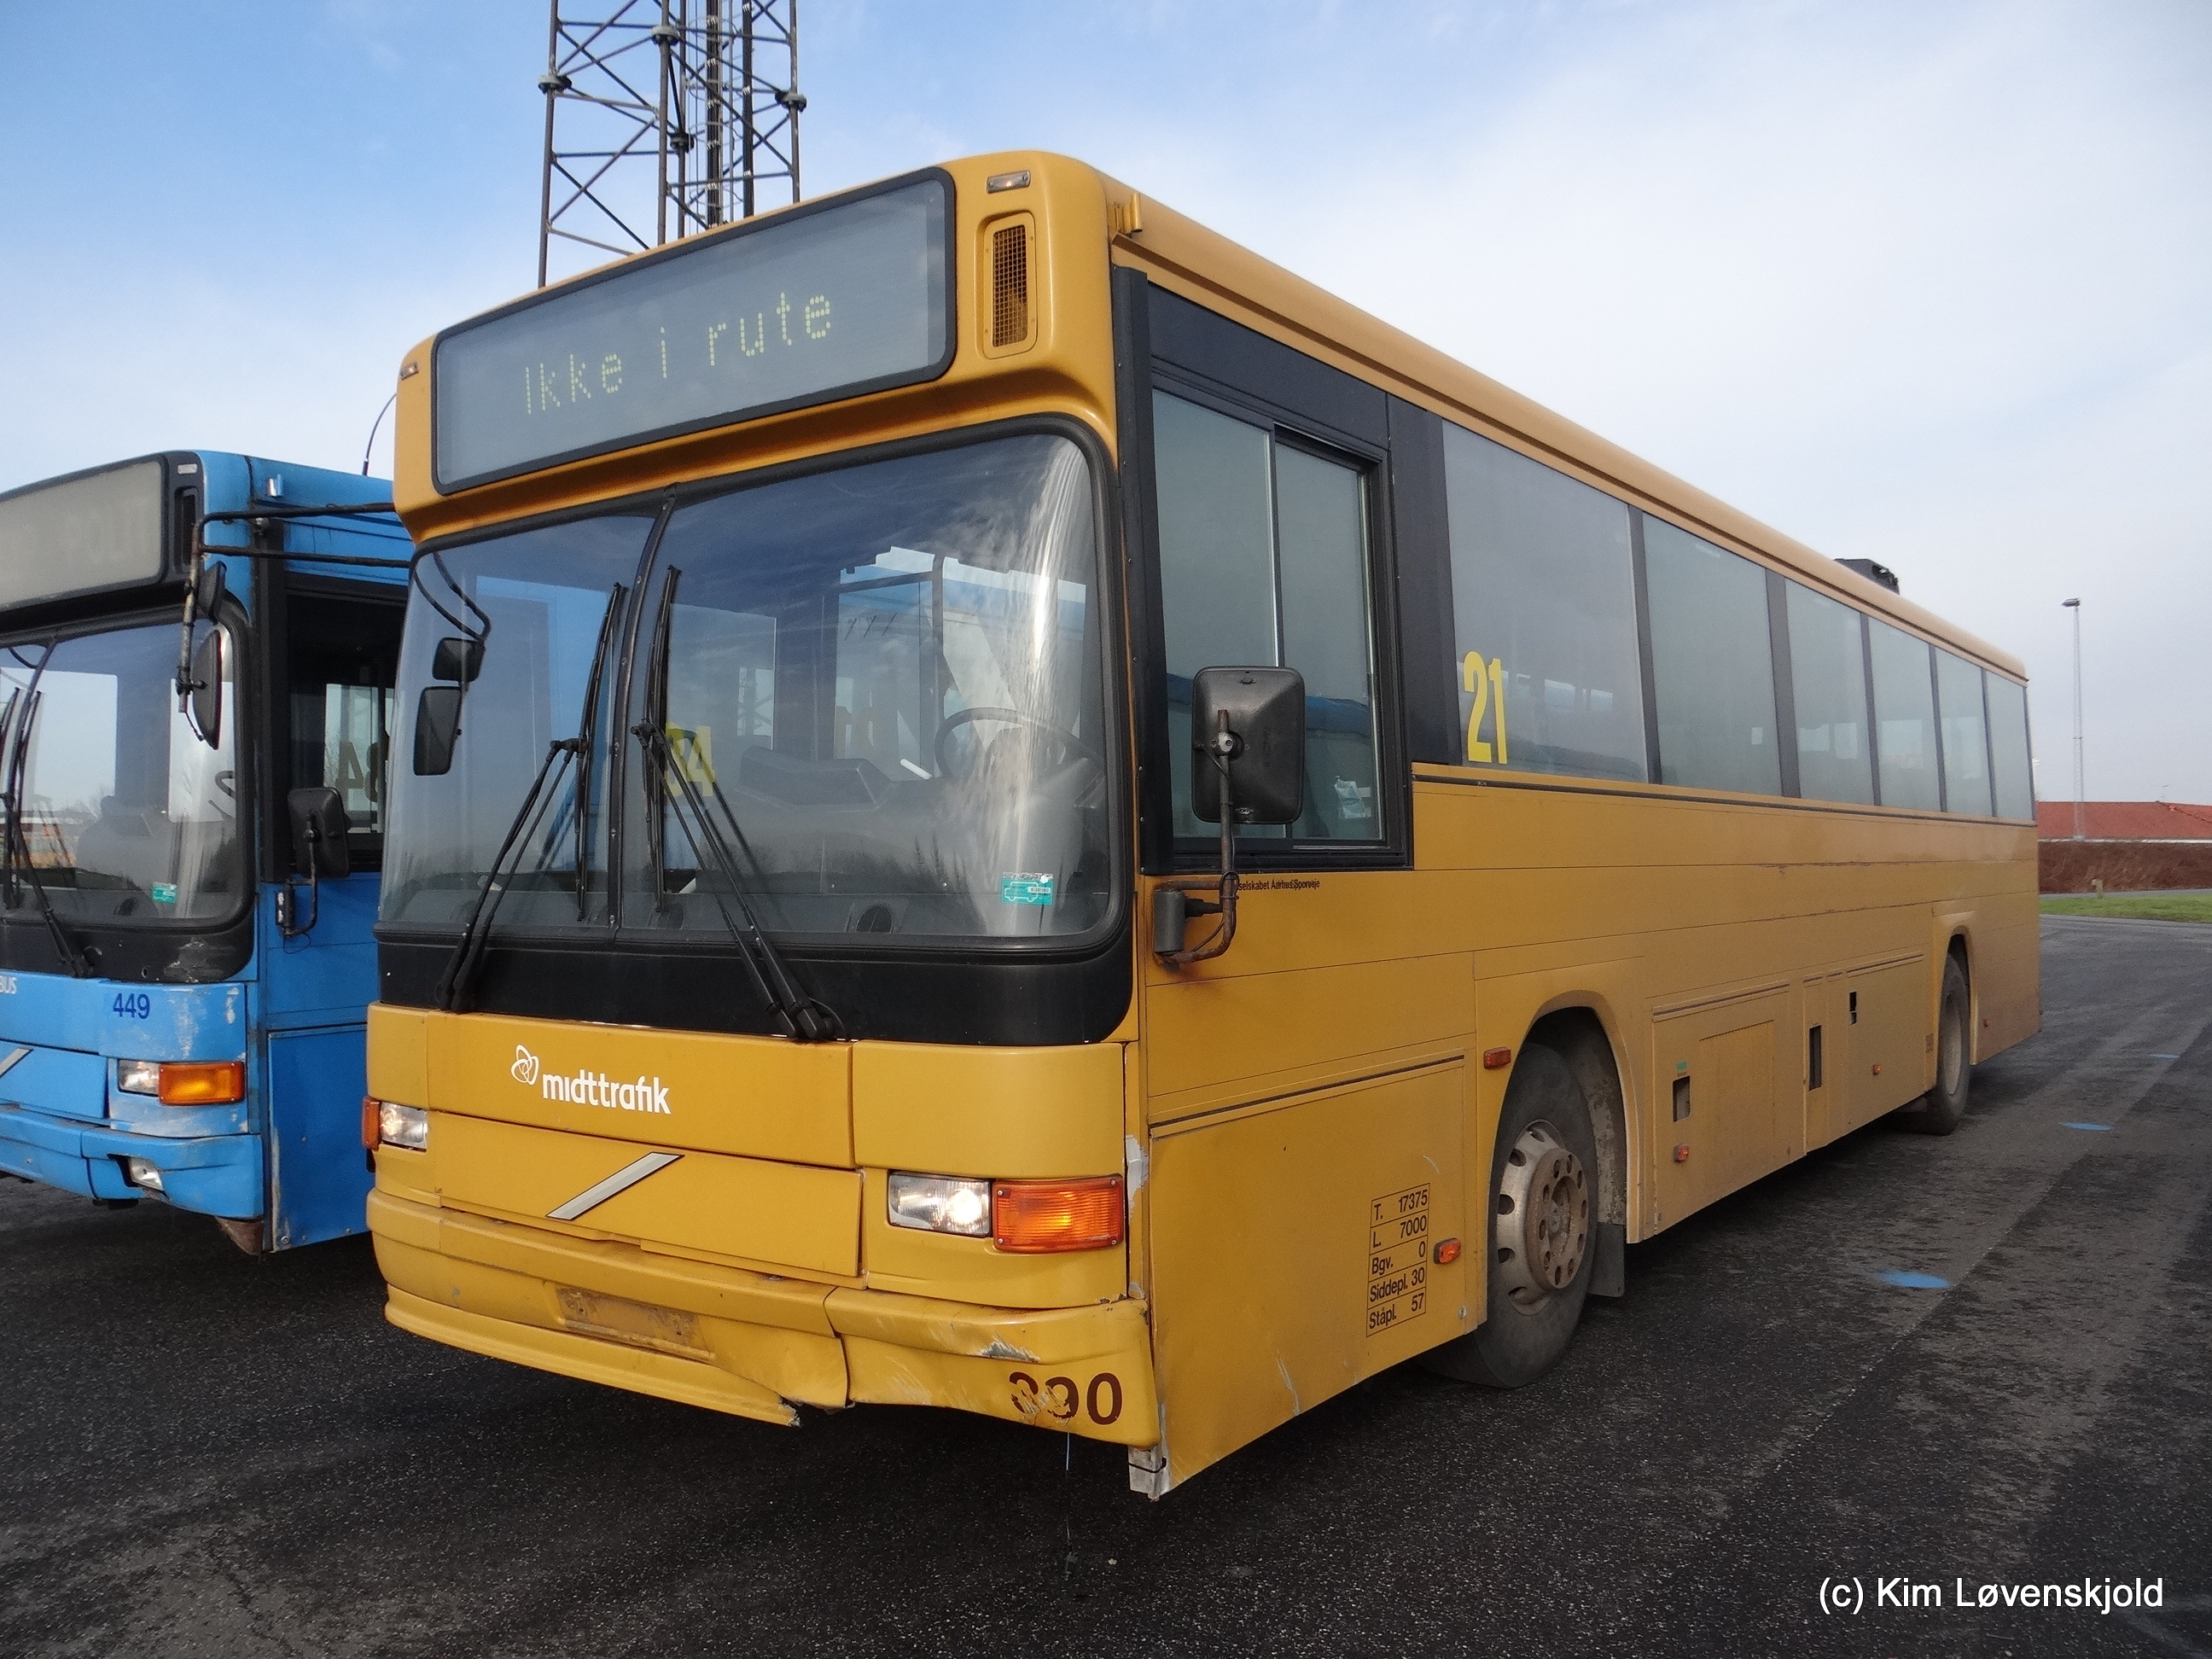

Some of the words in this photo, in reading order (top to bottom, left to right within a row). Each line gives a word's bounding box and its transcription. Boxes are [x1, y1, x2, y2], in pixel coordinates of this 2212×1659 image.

[525, 352, 622, 415] Ikke
[660, 326, 667, 379] i
[708, 292, 830, 366] rute
[1464, 651, 1507, 765] 21
[1237, 880, 1270, 891] selskabet
[113, 993, 150, 1019] 449
[542, 1068, 672, 1115] midttrafik
[1374, 1203, 1383, 1220] T.
[1399, 1189, 1428, 1213] 17375
[1372, 1231, 1382, 1248] L.
[1400, 1214, 1427, 1238] 7000
[1371, 1256, 1394, 1276] Bgv.
[1418, 1241, 1426, 1258] 0
[1370, 1273, 1408, 1303] Siddepl.
[1412, 1266, 1425, 1286] 30
[1369, 1303, 1397, 1329] Ståpl.
[1411, 1292, 1424, 1312] 57
